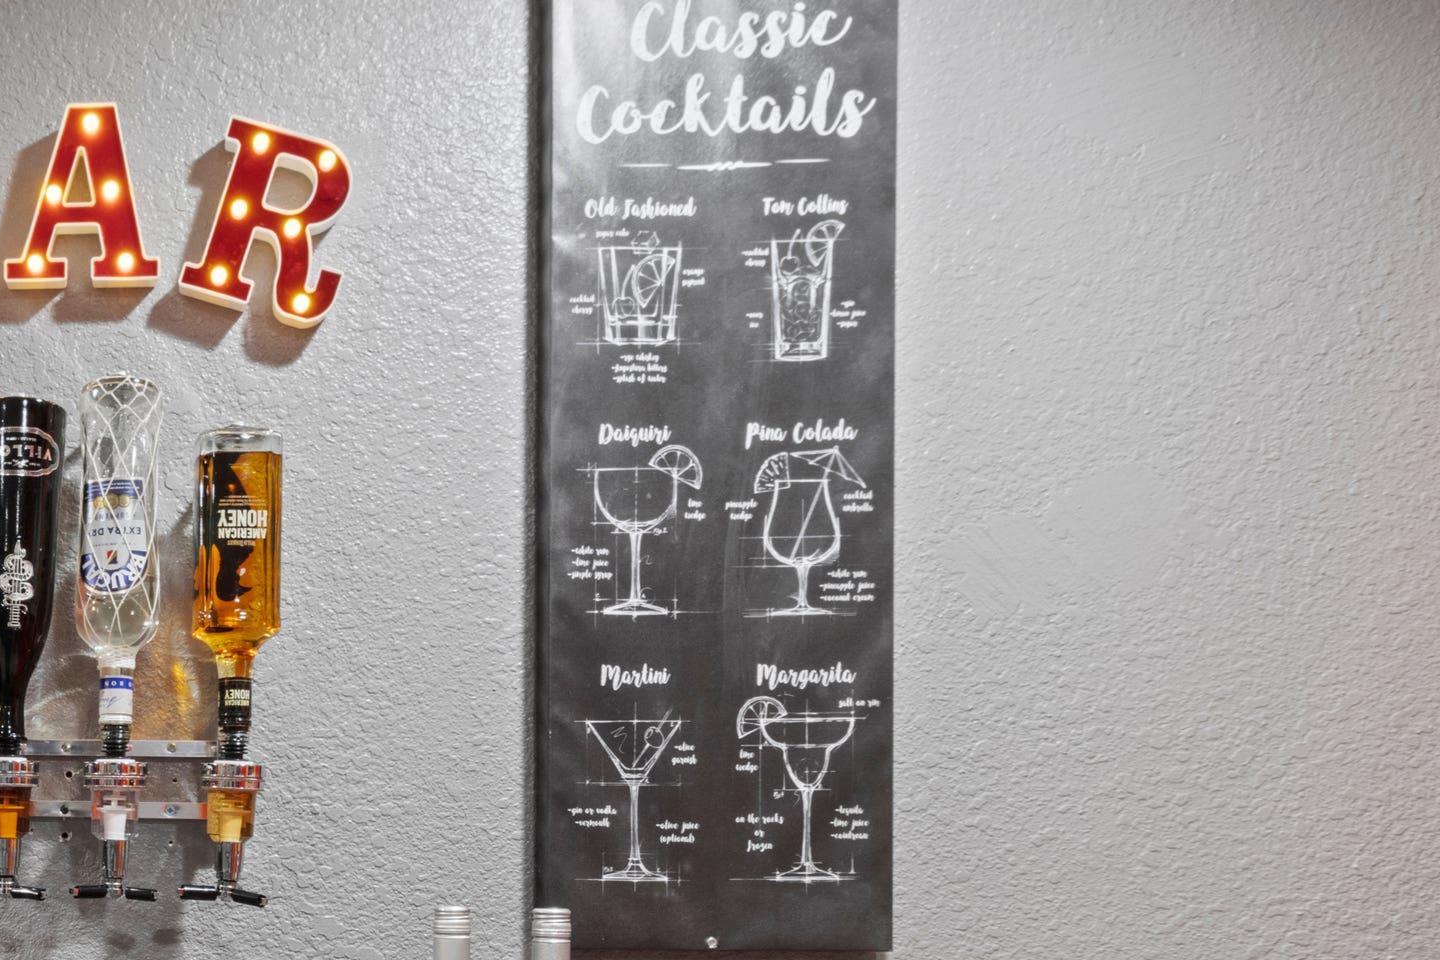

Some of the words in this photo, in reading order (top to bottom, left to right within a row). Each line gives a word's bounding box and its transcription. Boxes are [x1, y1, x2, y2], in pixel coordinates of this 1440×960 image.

[630, 0, 853, 61] Classic
[576, 67, 877, 144] Cocktails
[584, 196, 618, 219] Old
[622, 196, 697, 220] Fashioned
[762, 197, 794, 216] Tom
[797, 193, 849, 215] Collins
[597, 422, 673, 447] Daiquiri
[745, 420, 788, 449] Pina
[792, 418, 859, 443] Colada
[217, 509, 268, 527] HONEY
[218, 528, 267, 539] AMERICAN
[600, 663, 671, 690] Martini
[756, 661, 858, 690] Margarita
[224, 689, 250, 699] HONEY
